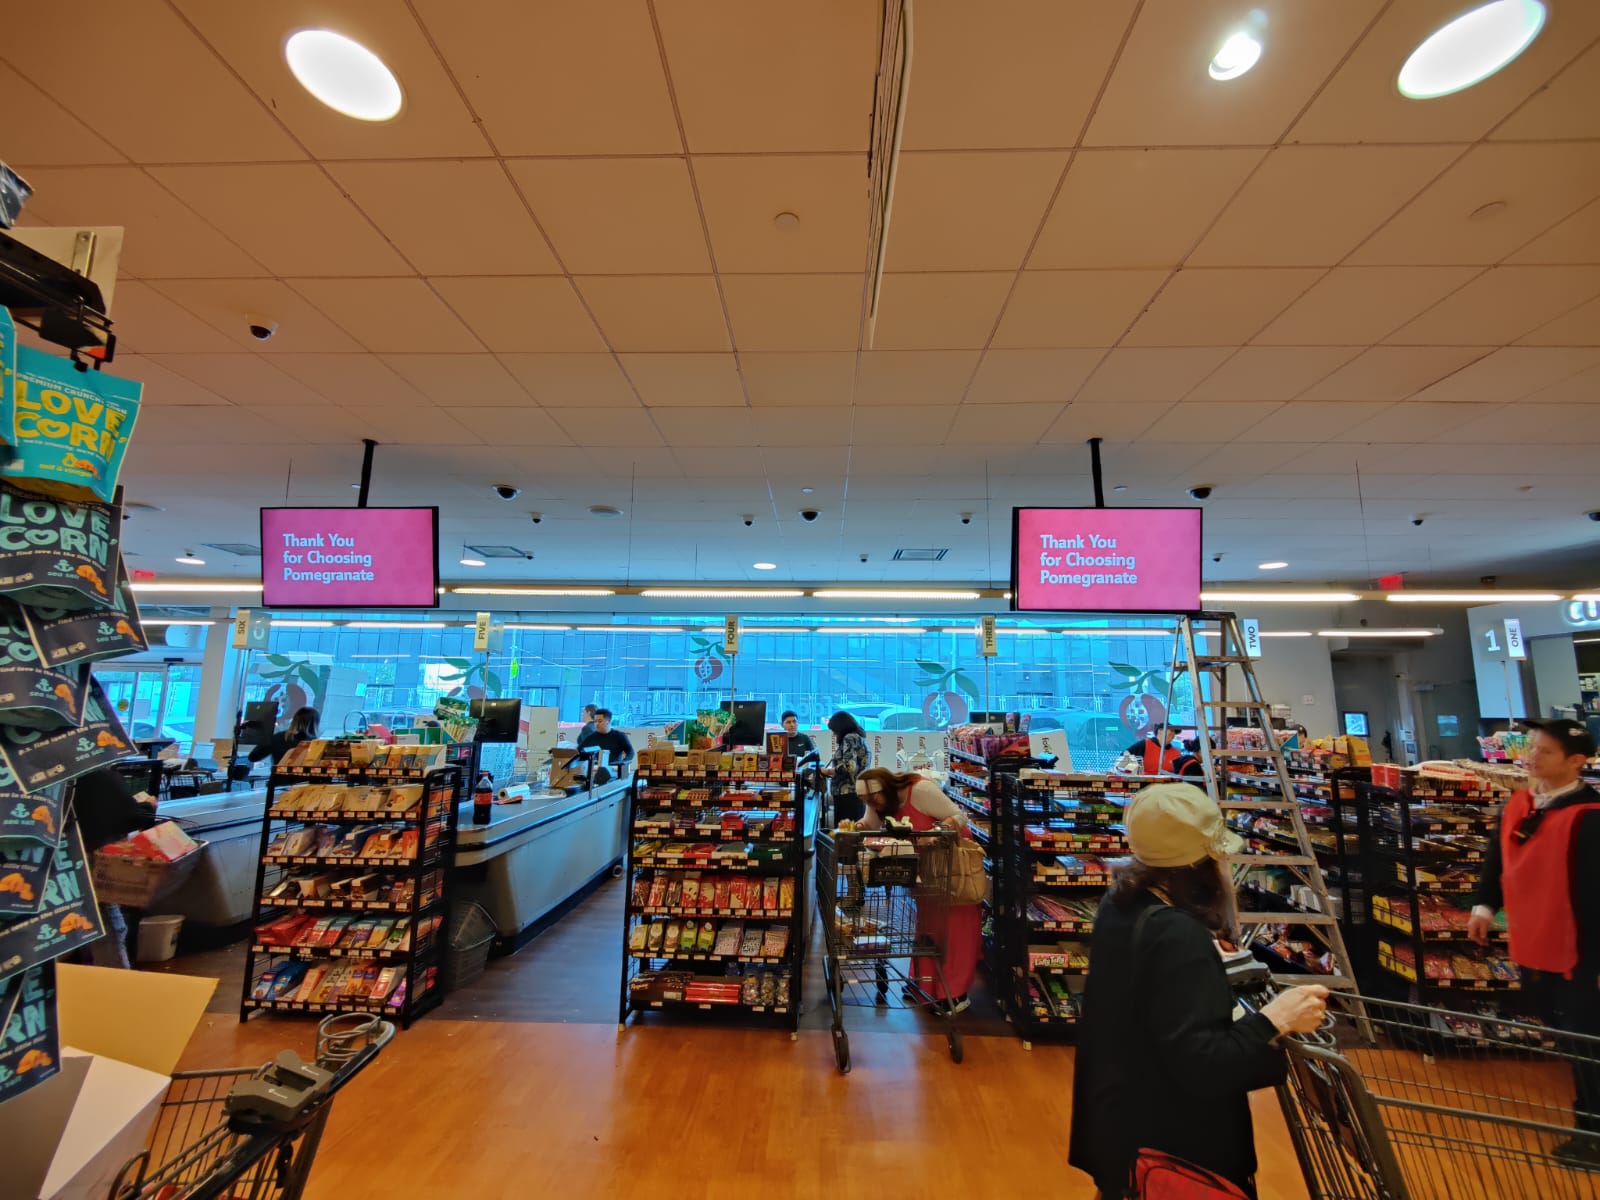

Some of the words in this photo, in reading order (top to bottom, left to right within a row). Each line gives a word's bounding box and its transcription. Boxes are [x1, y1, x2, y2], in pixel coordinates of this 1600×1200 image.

[15, 411, 116, 463] CORN
[0, 526, 109, 567] CORN
[283, 533, 324, 547] Thank
[328, 533, 354, 547] You
[1040, 534, 1084, 549] Thank
[1088, 534, 1117, 549] You
[283, 550, 303, 564] for
[307, 550, 372, 567] Choosing
[1040, 552, 1062, 567] for
[1066, 552, 1136, 569] Choosing
[283, 567, 374, 584] Pomegranate
[1040, 570, 1138, 587] Pomegranate
[238, 620, 246, 635] SIX
[478, 621, 487, 640] FIVE
[727, 621, 736, 645] FOUR
[985, 620, 993, 648] THREE
[1247, 626, 1257, 648] TWO
[1509, 627, 1519, 647] ONE
[1485, 630, 1500, 652] 1
